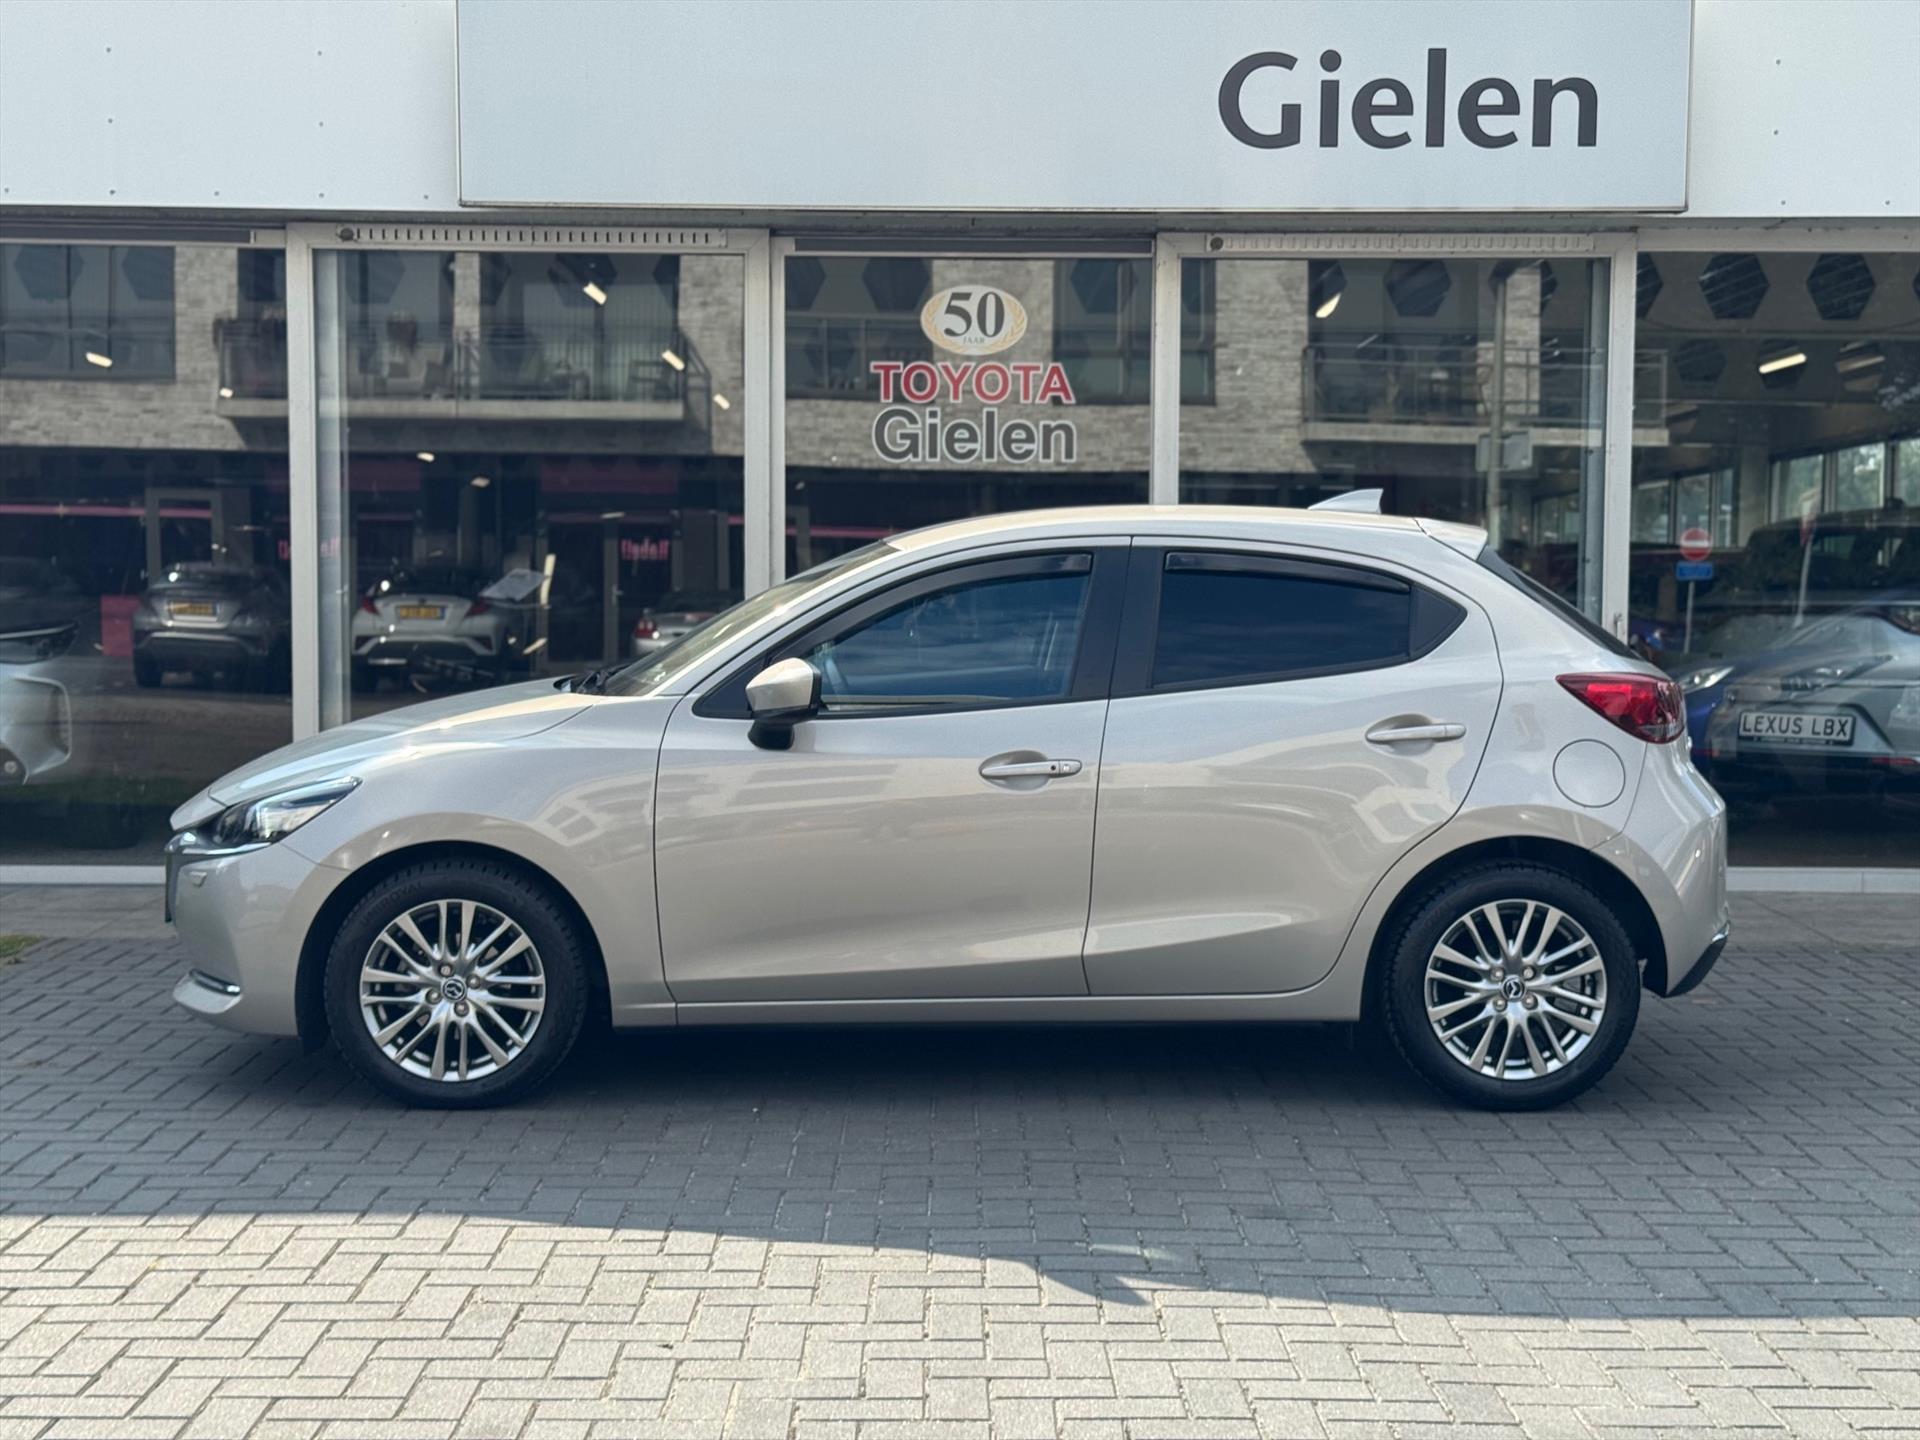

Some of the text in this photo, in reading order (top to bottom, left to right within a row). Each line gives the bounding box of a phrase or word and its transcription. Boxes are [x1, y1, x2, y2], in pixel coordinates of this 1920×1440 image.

[1218, 48, 1598, 149] Gielen
[943, 291, 1005, 337] 50
[871, 362, 1074, 403] TOYOTA
[874, 407, 1076, 463] Gielen
[1742, 714, 1849, 737] LEXUS LBX
